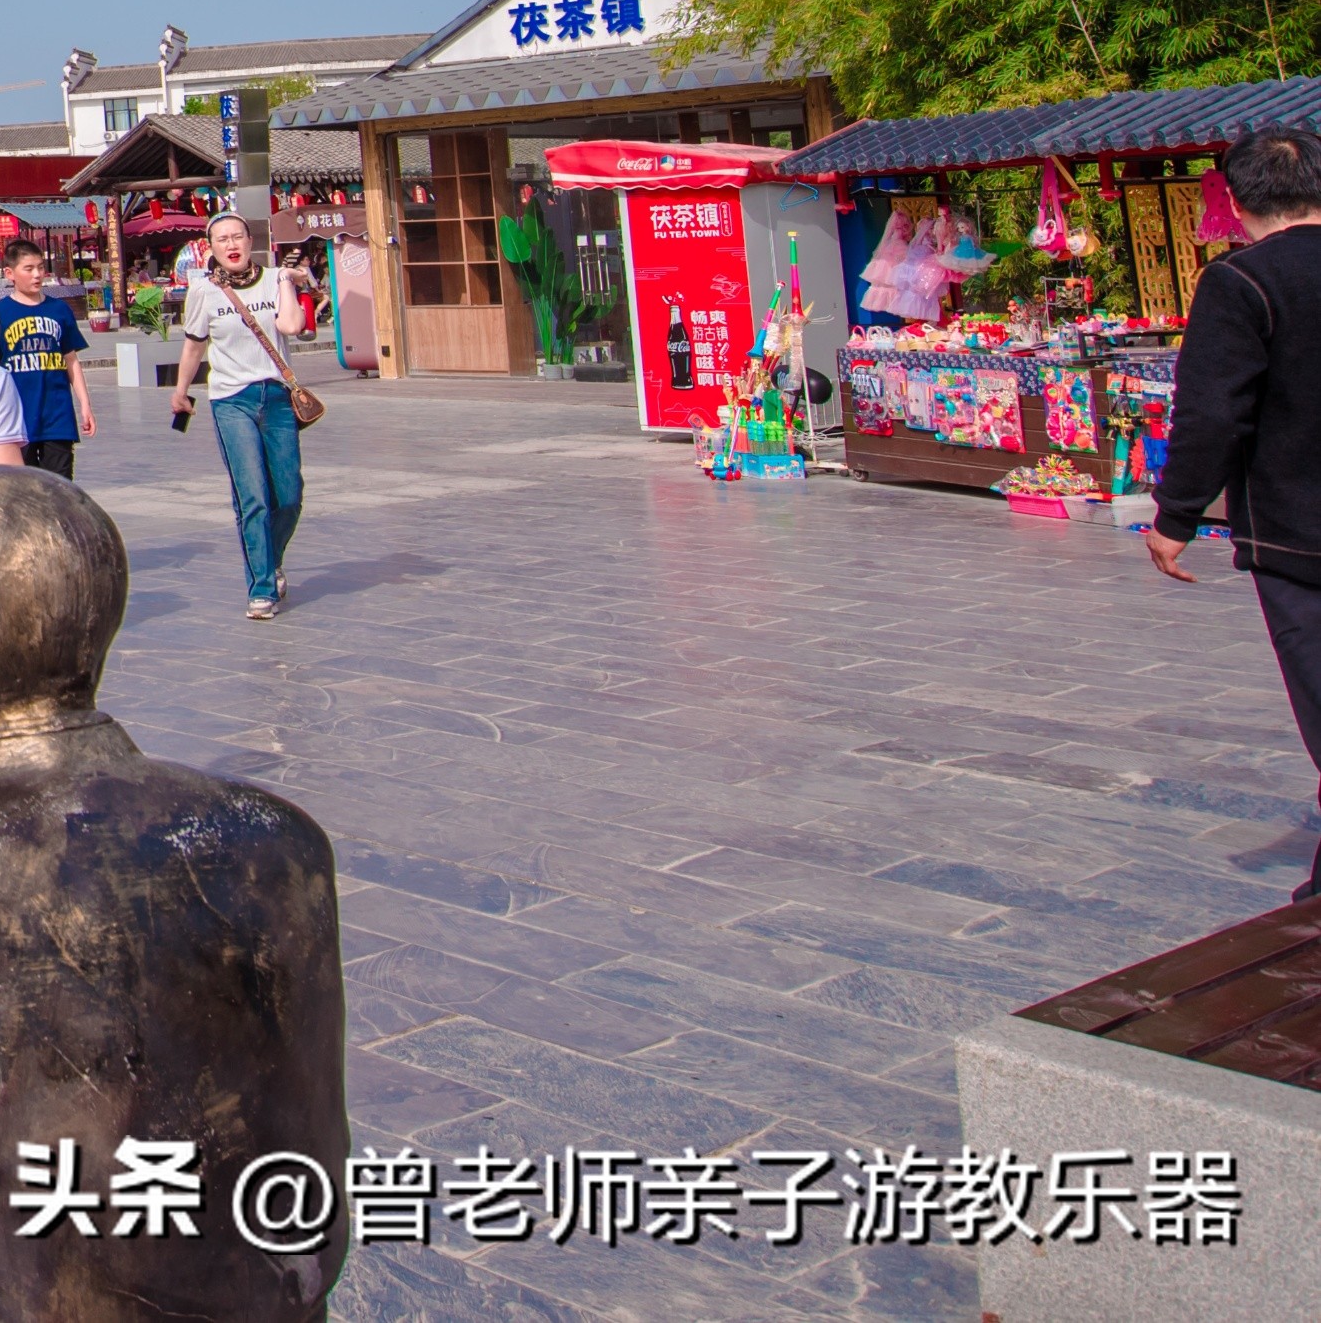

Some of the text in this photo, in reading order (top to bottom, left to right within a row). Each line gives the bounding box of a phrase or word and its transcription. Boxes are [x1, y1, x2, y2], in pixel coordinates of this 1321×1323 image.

[307, 213, 345, 228] 棉花糖
[649, 203, 720, 230] 茯茶镇
[654, 229, 720, 239] FU TEA TOWN
[690, 310, 727, 325] 畅爽
[692, 326, 729, 340] 游古镇
